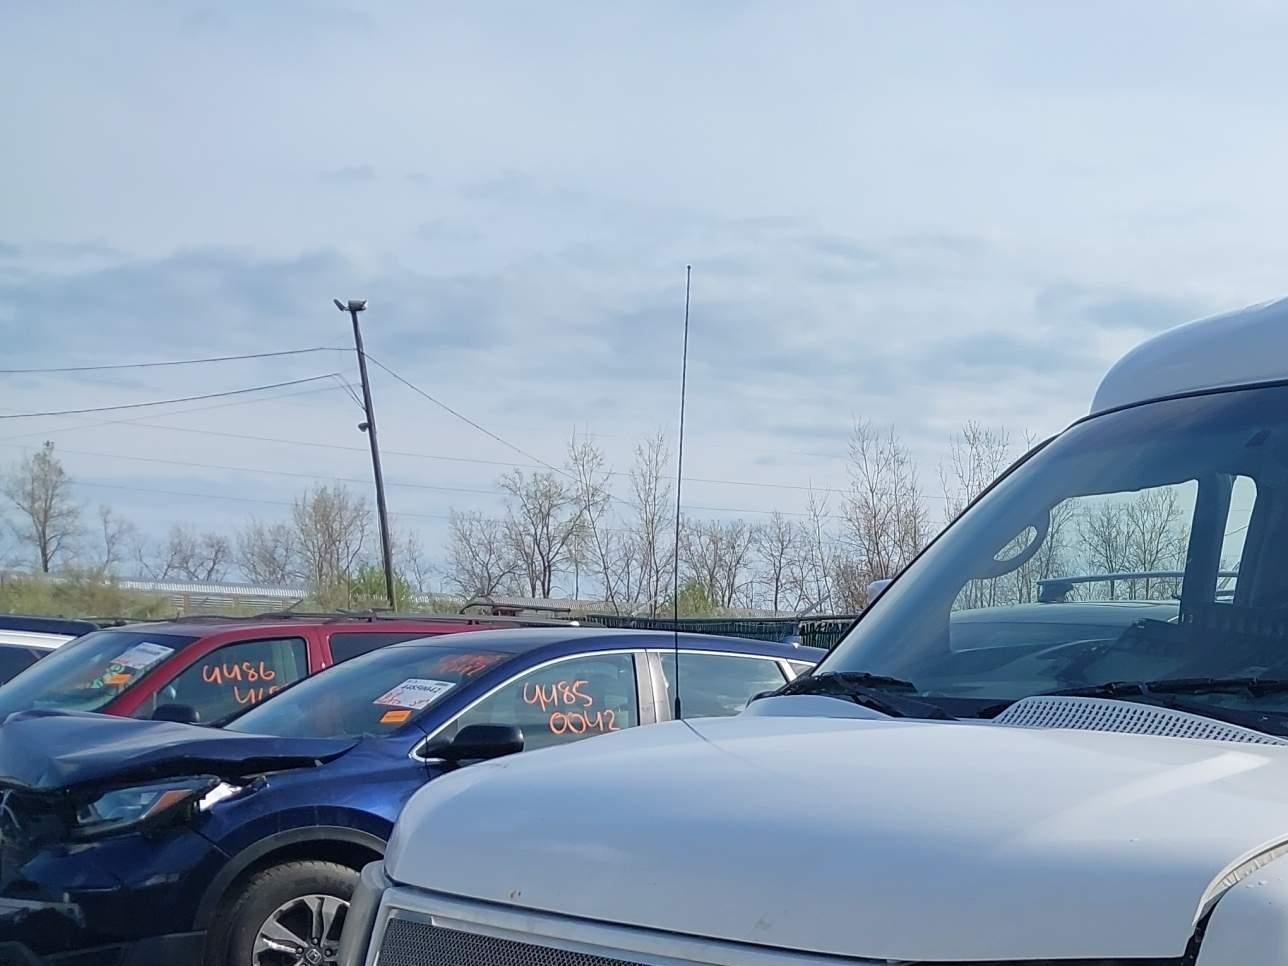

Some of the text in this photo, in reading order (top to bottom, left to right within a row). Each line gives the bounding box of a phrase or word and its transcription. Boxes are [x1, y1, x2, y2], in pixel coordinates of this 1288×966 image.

[202, 660, 276, 685] 4486
[523, 680, 593, 712] 4485
[549, 709, 621, 734] 0042
